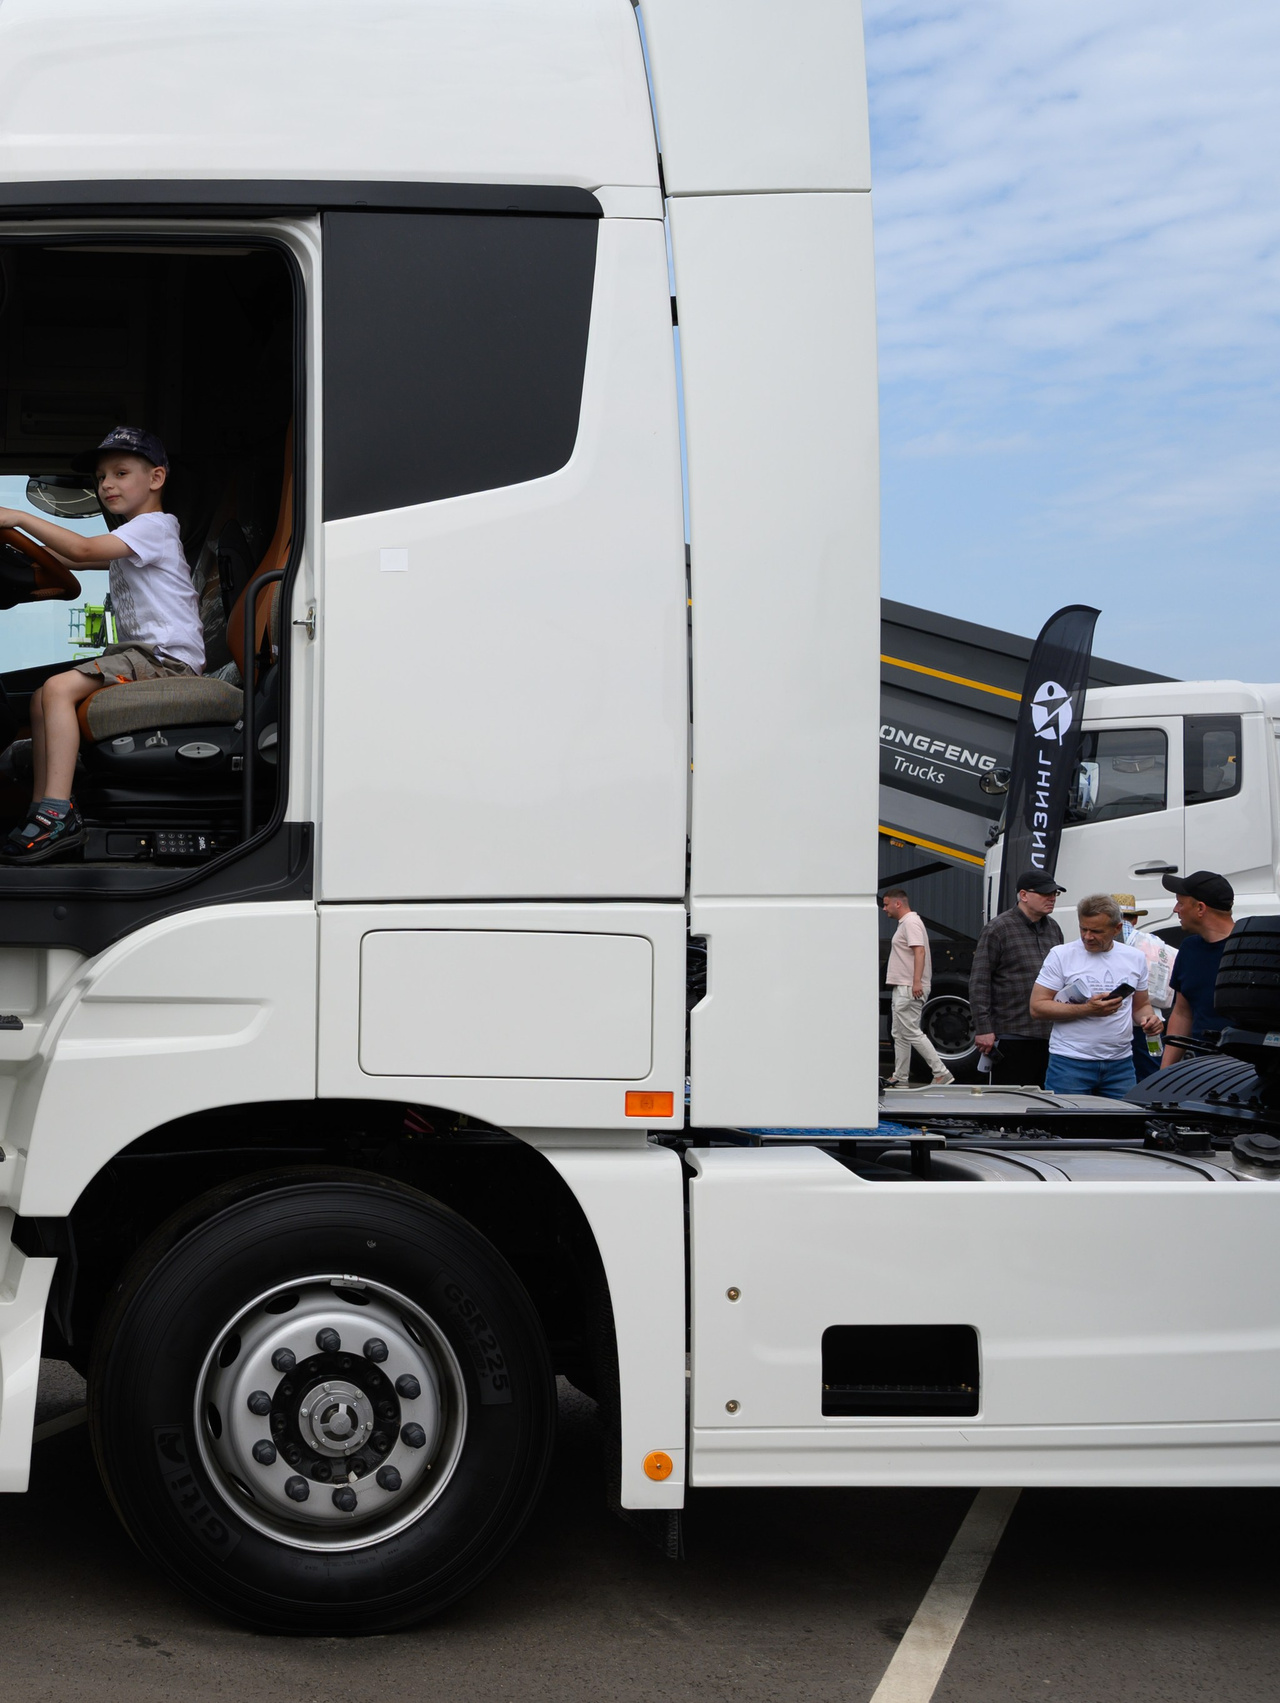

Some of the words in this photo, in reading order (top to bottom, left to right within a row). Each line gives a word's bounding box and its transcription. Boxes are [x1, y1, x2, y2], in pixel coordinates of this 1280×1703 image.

[879, 724, 997, 771] ONGFENG
[894, 755, 945, 784] Trucks
[1031, 749, 1052, 869] ЛИЗИНГ
